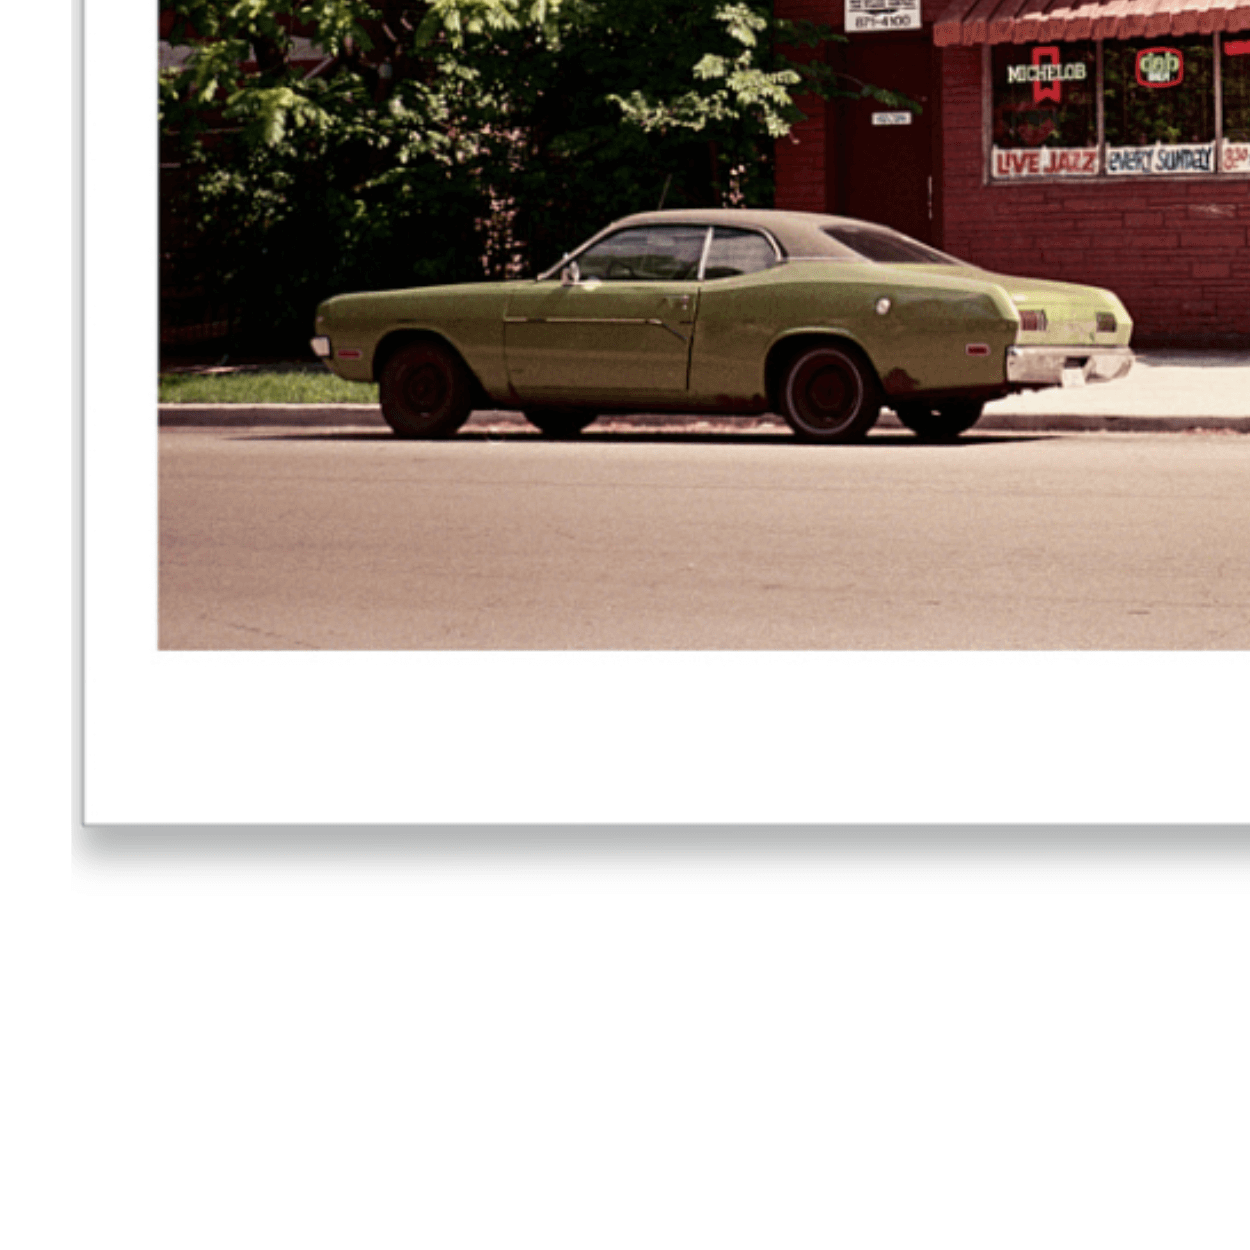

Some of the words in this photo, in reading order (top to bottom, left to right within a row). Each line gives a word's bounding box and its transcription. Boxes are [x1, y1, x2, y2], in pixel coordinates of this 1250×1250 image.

[1007, 62, 1087, 83] MICHELOB
[997, 152, 1040, 174] LIVE
[1043, 151, 1096, 173] JAZZ
